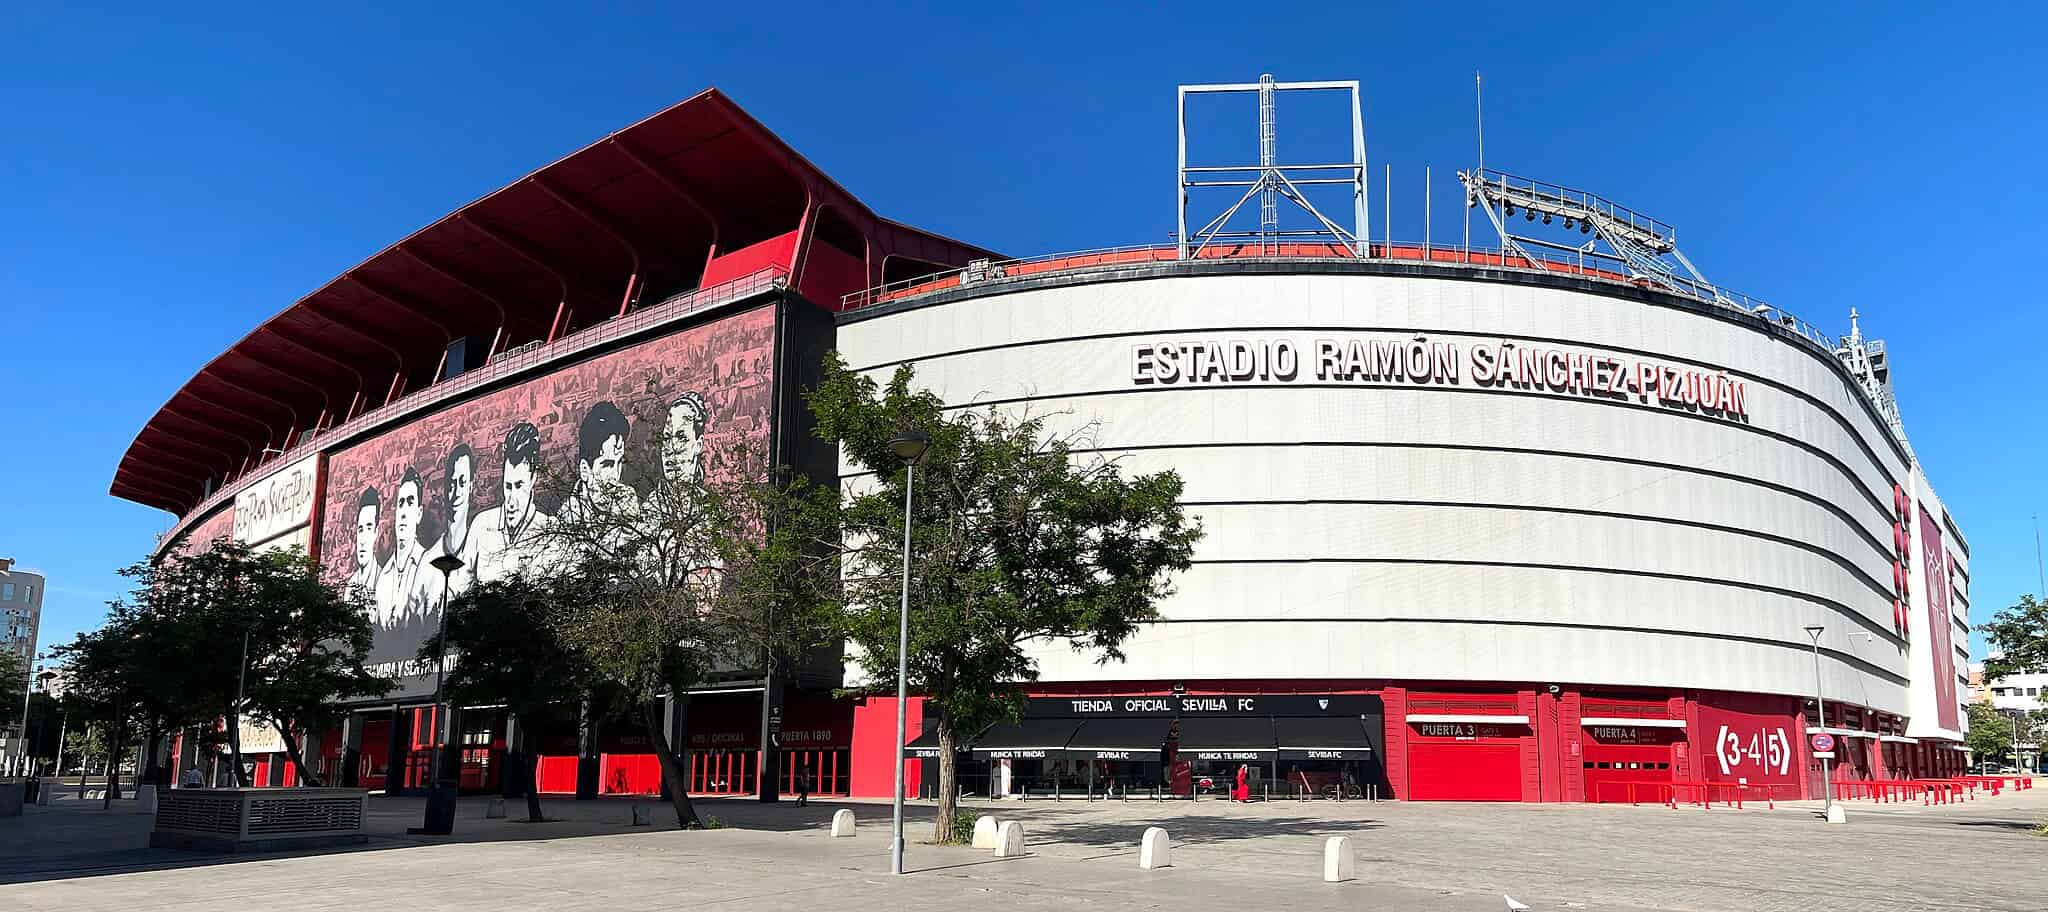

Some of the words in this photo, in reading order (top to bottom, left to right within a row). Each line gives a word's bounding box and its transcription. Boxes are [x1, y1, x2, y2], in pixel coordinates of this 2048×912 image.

[1131, 339, 1298, 385] ESTADIO
[1315, 332, 1460, 385] RAMÓN
[1072, 700, 1113, 712] TIENDA
[1125, 699, 1171, 712] OFICIAL
[1182, 698, 1227, 711] SEVILLA
[1238, 698, 1254, 710] FC
[1422, 724, 1463, 736] PUERTA
[1467, 725, 1475, 735] 3
[1594, 727, 1628, 738] PUERTA
[1630, 729, 1636, 738] 4
